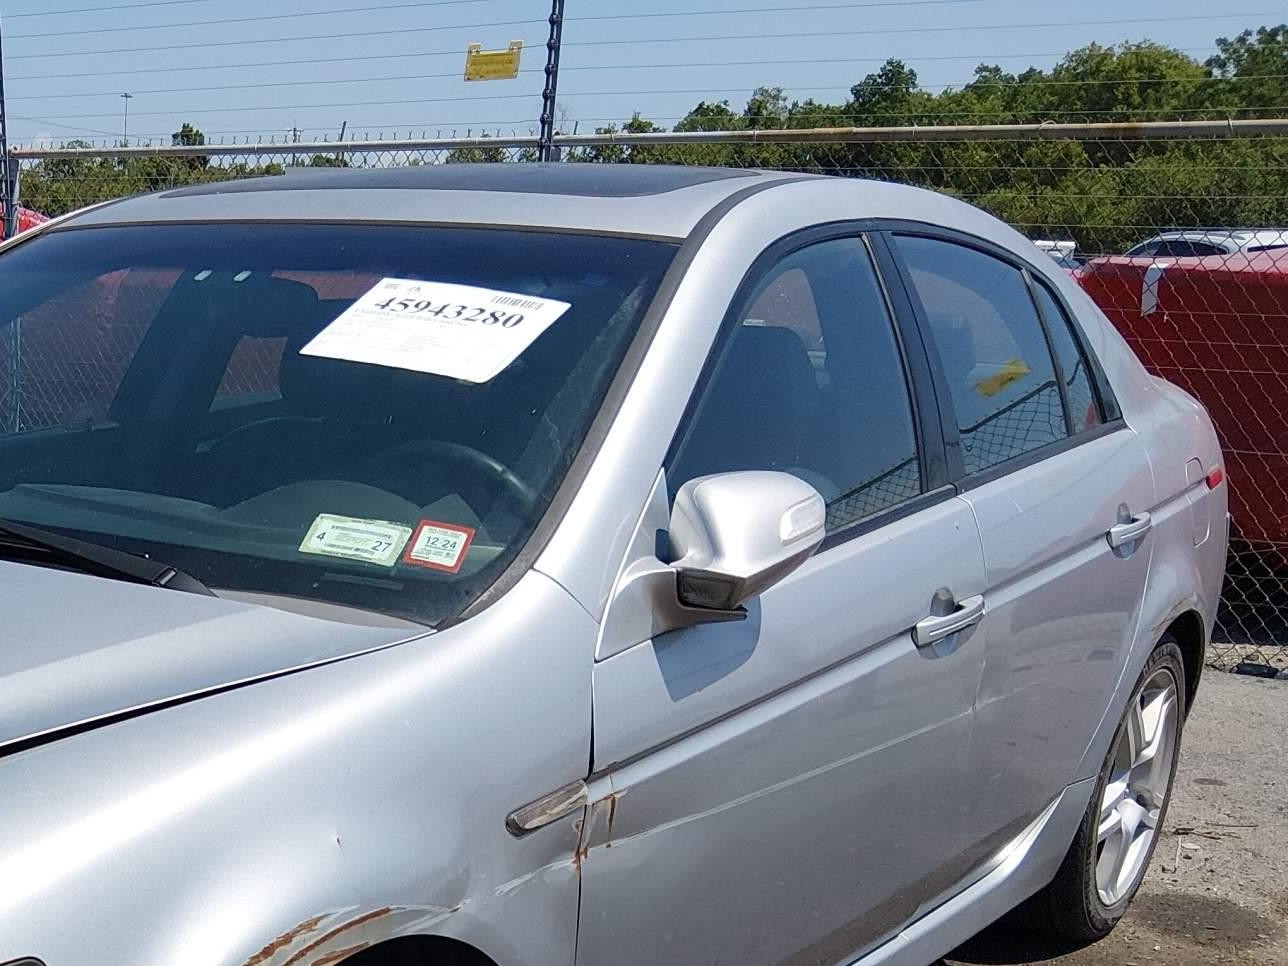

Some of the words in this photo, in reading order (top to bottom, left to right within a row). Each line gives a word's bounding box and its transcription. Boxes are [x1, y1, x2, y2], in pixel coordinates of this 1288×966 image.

[373, 296, 525, 329] 45943280
[316, 531, 327, 542] 4
[425, 534, 439, 546] 12
[441, 538, 458, 550] 24
[371, 540, 392, 553] 27
